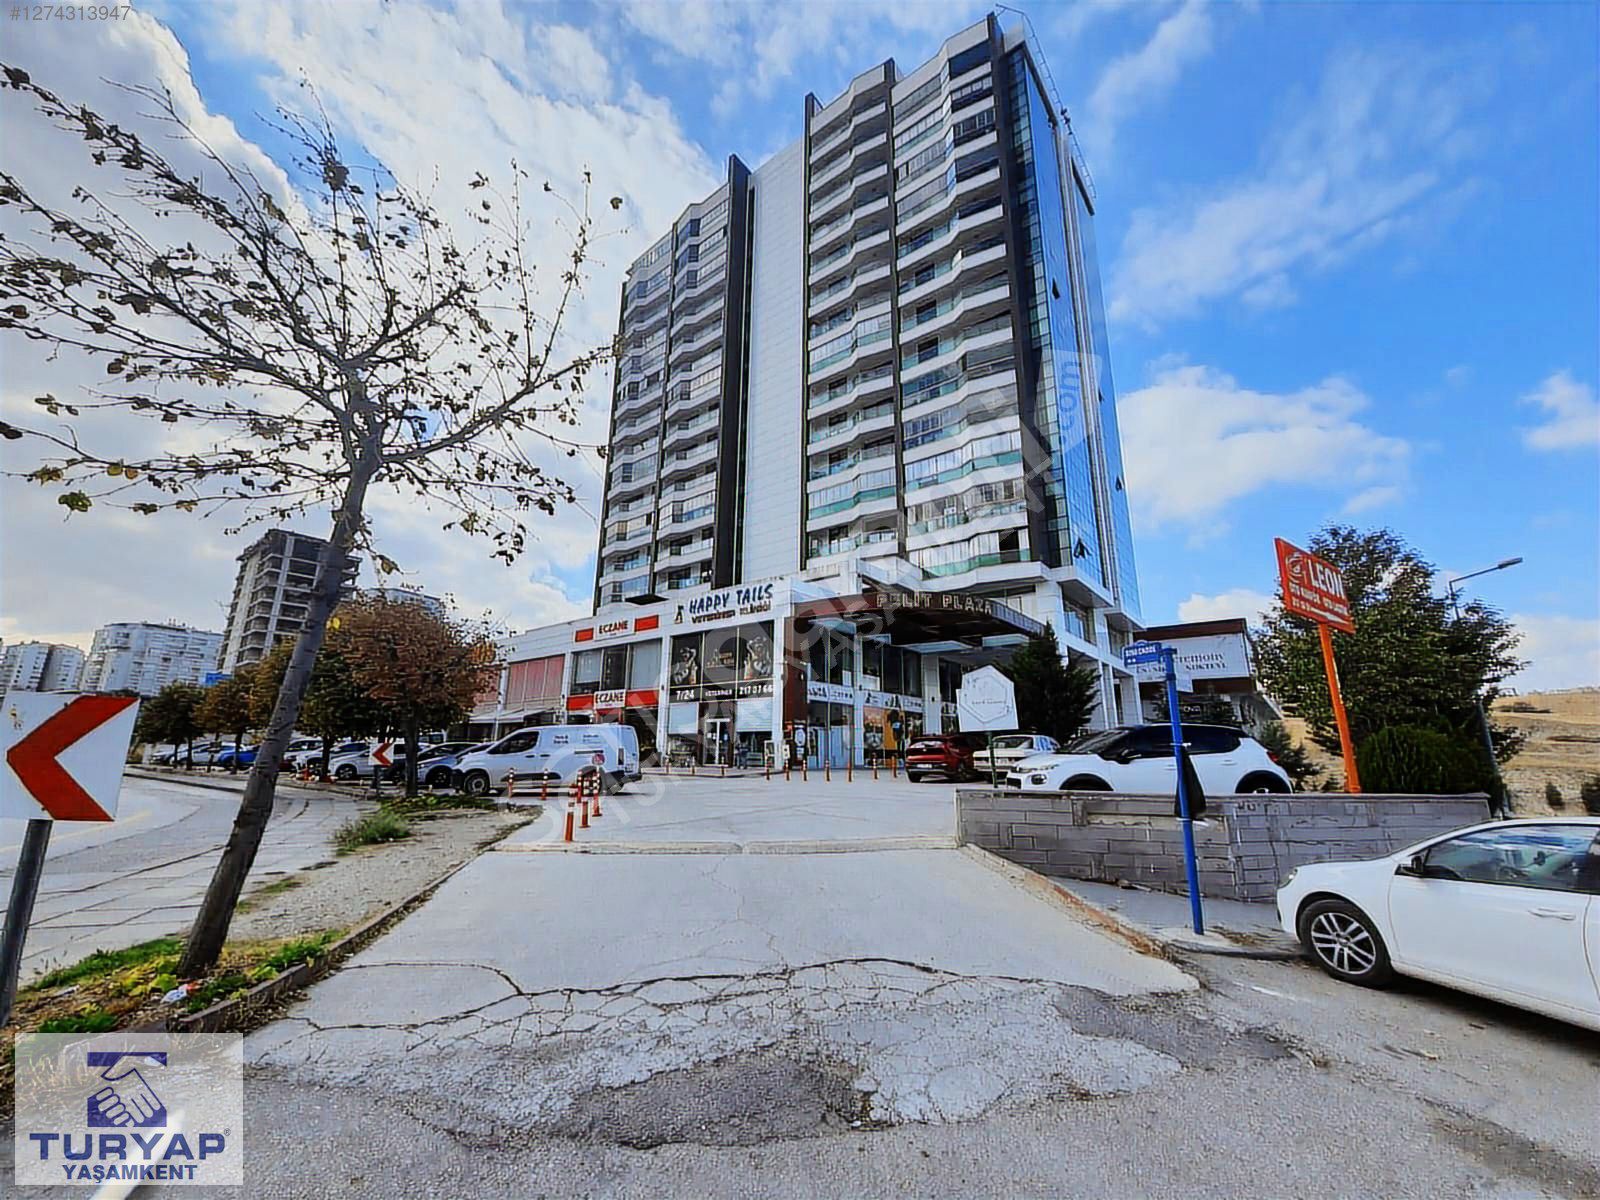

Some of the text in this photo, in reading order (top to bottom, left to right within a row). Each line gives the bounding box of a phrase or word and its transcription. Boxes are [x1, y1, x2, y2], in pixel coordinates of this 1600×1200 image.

[1307, 559, 1346, 599] LEON
[688, 583, 774, 615] HAPPY TAILS
[942, 594, 993, 615] PLAZA
[598, 619, 630, 634] ECZANE
[595, 691, 625, 704] ECZANE
